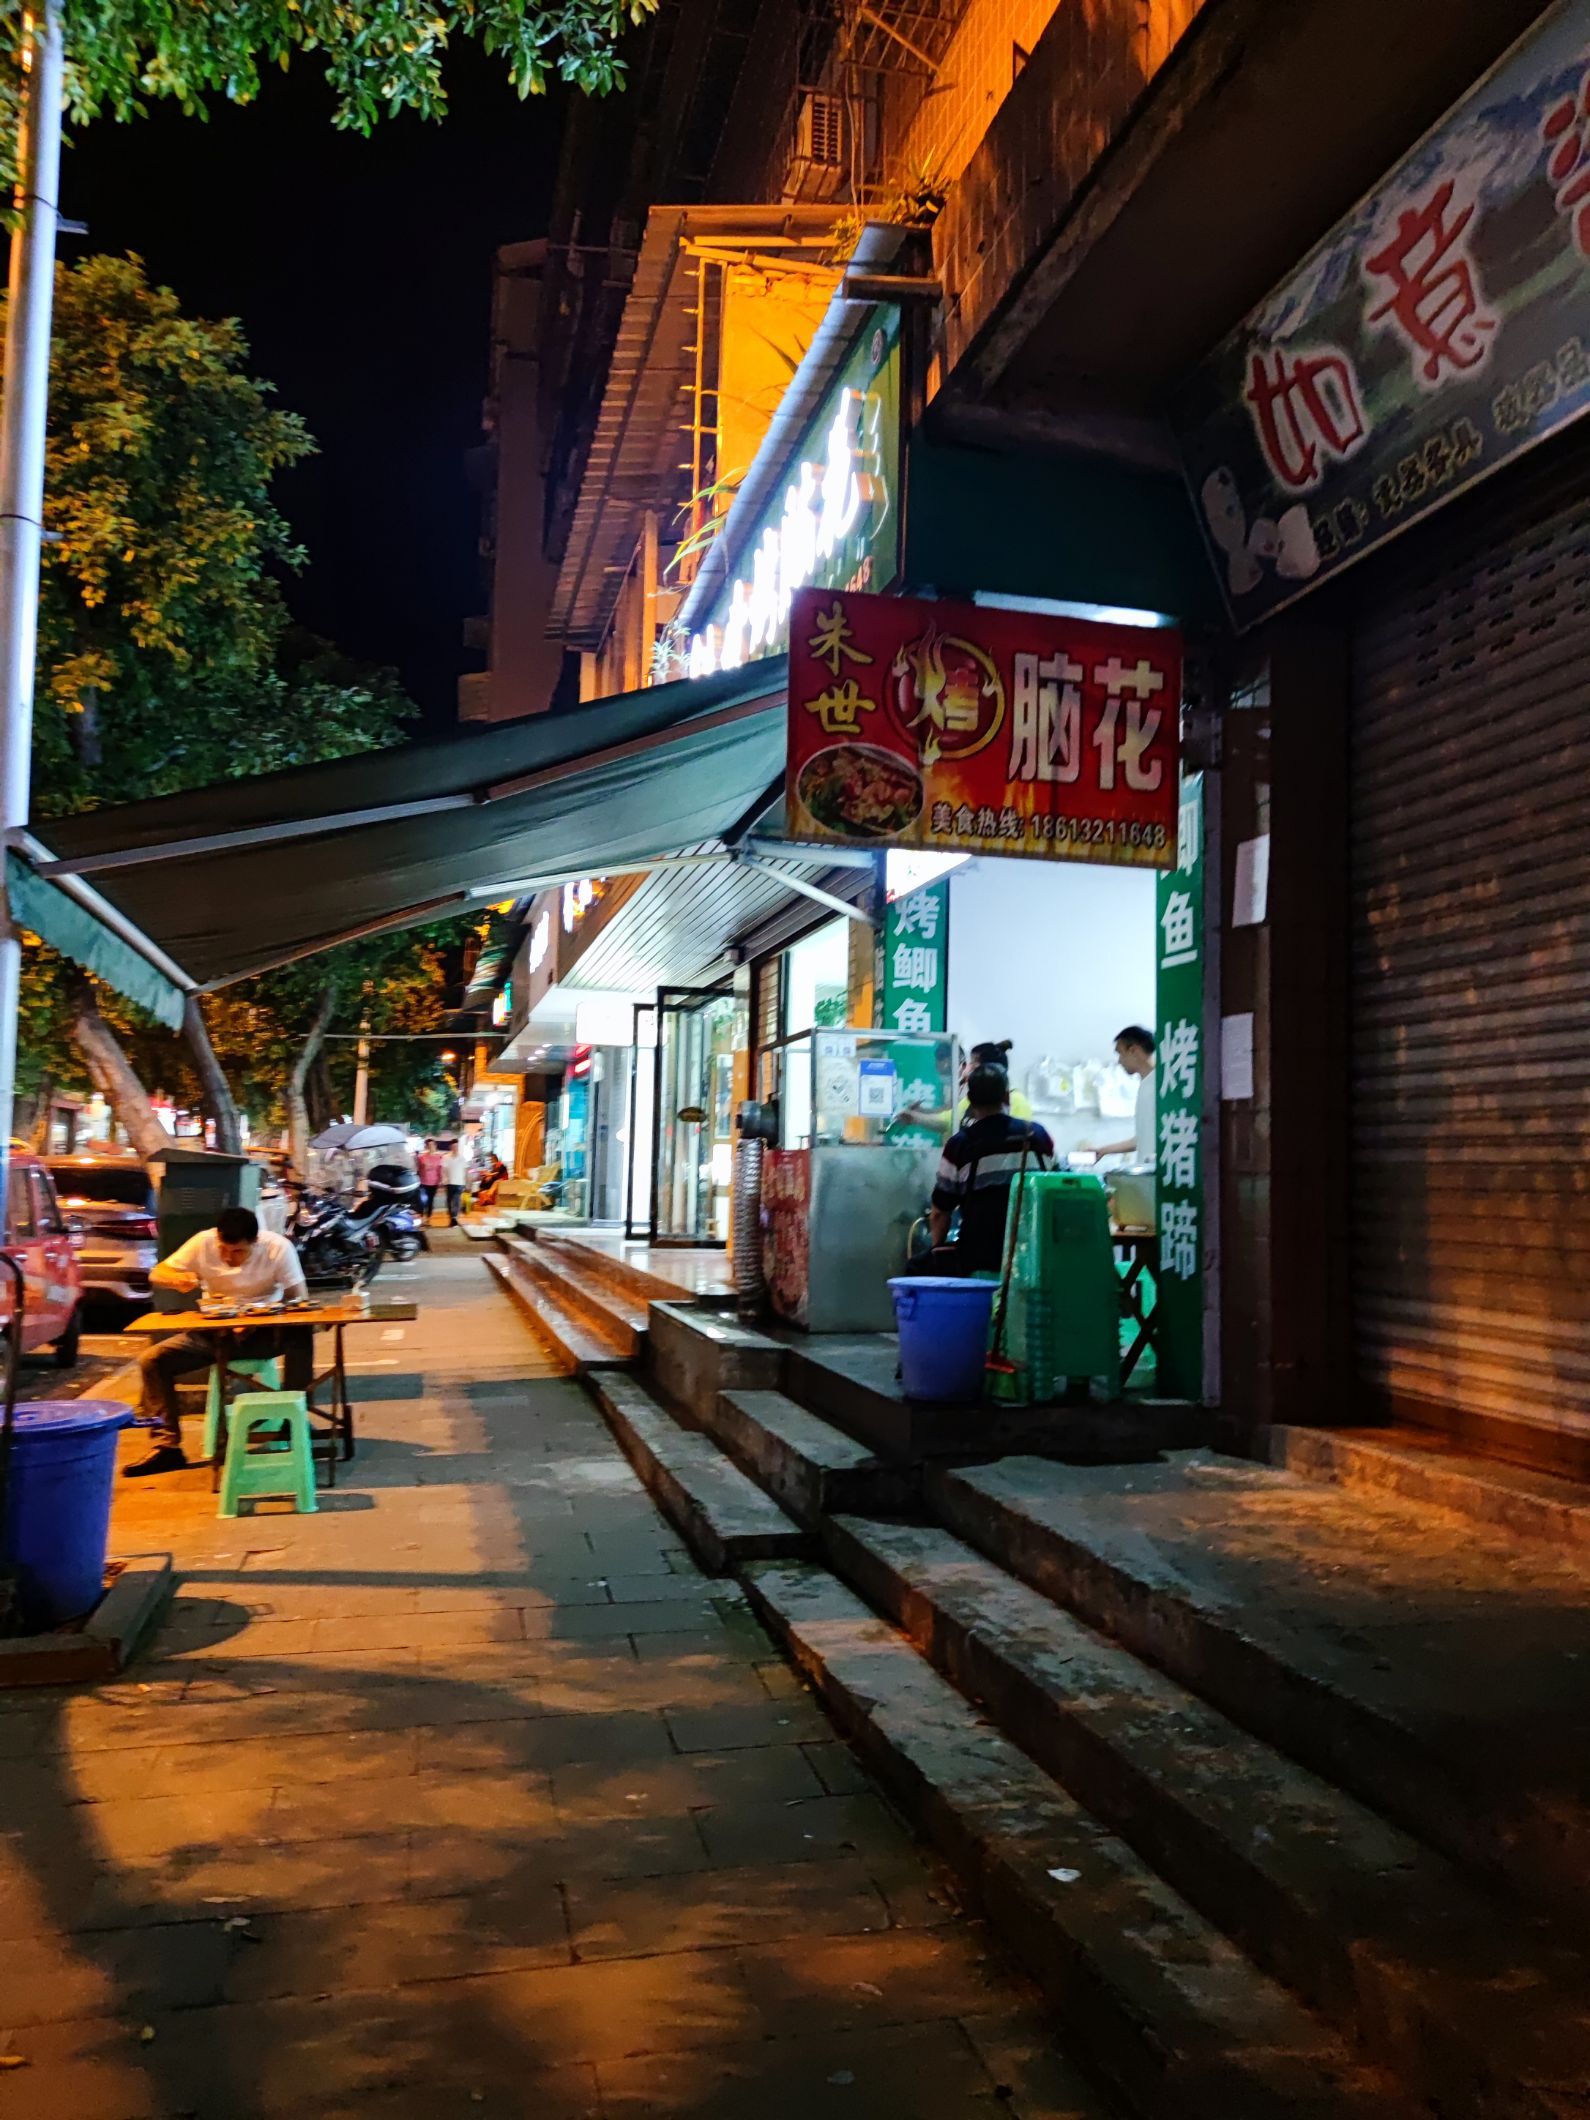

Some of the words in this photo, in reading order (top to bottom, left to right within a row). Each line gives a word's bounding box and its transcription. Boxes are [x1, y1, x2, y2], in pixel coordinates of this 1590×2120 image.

[804, 601, 875, 736] 朱世
[1159, 1018, 1200, 1282] 烤猪蹄
